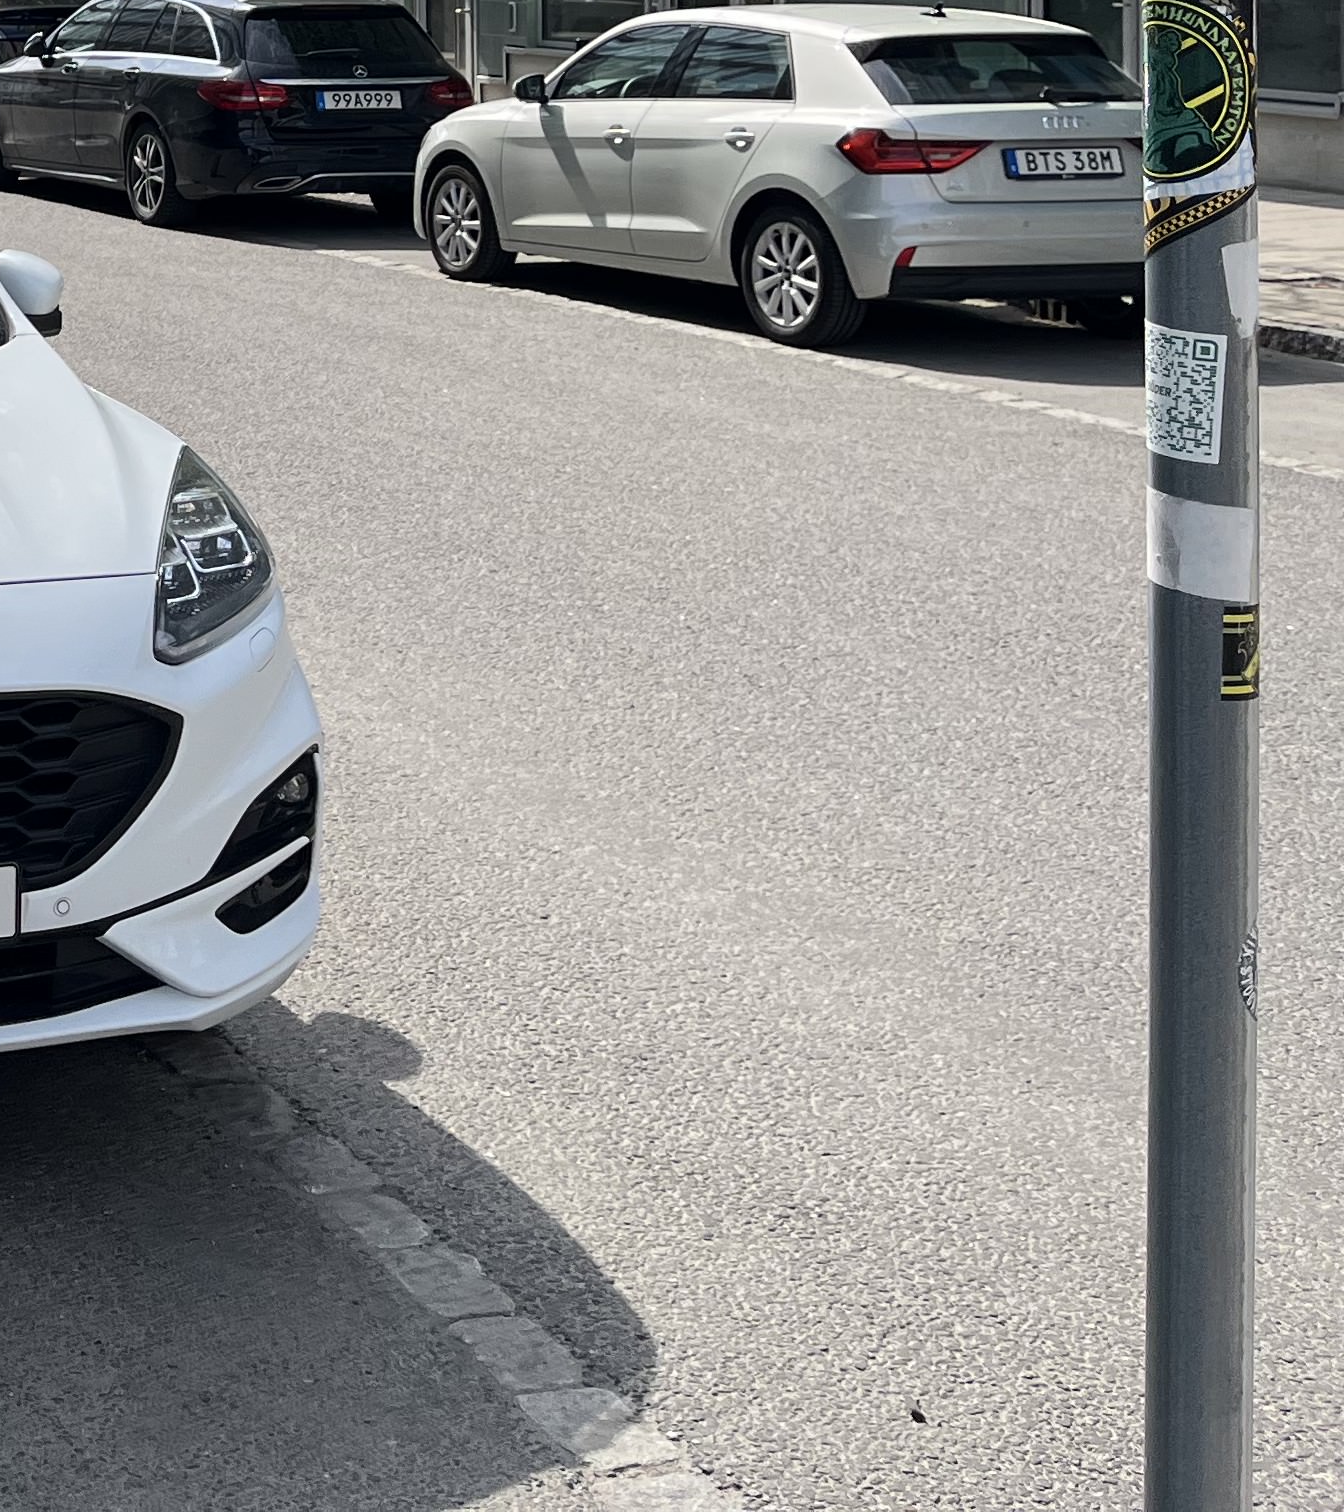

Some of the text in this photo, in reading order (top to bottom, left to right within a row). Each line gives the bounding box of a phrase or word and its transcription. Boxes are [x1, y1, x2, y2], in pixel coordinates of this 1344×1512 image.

[332, 92, 393, 108] 99A999
[1025, 150, 1114, 172] BTS 38M
